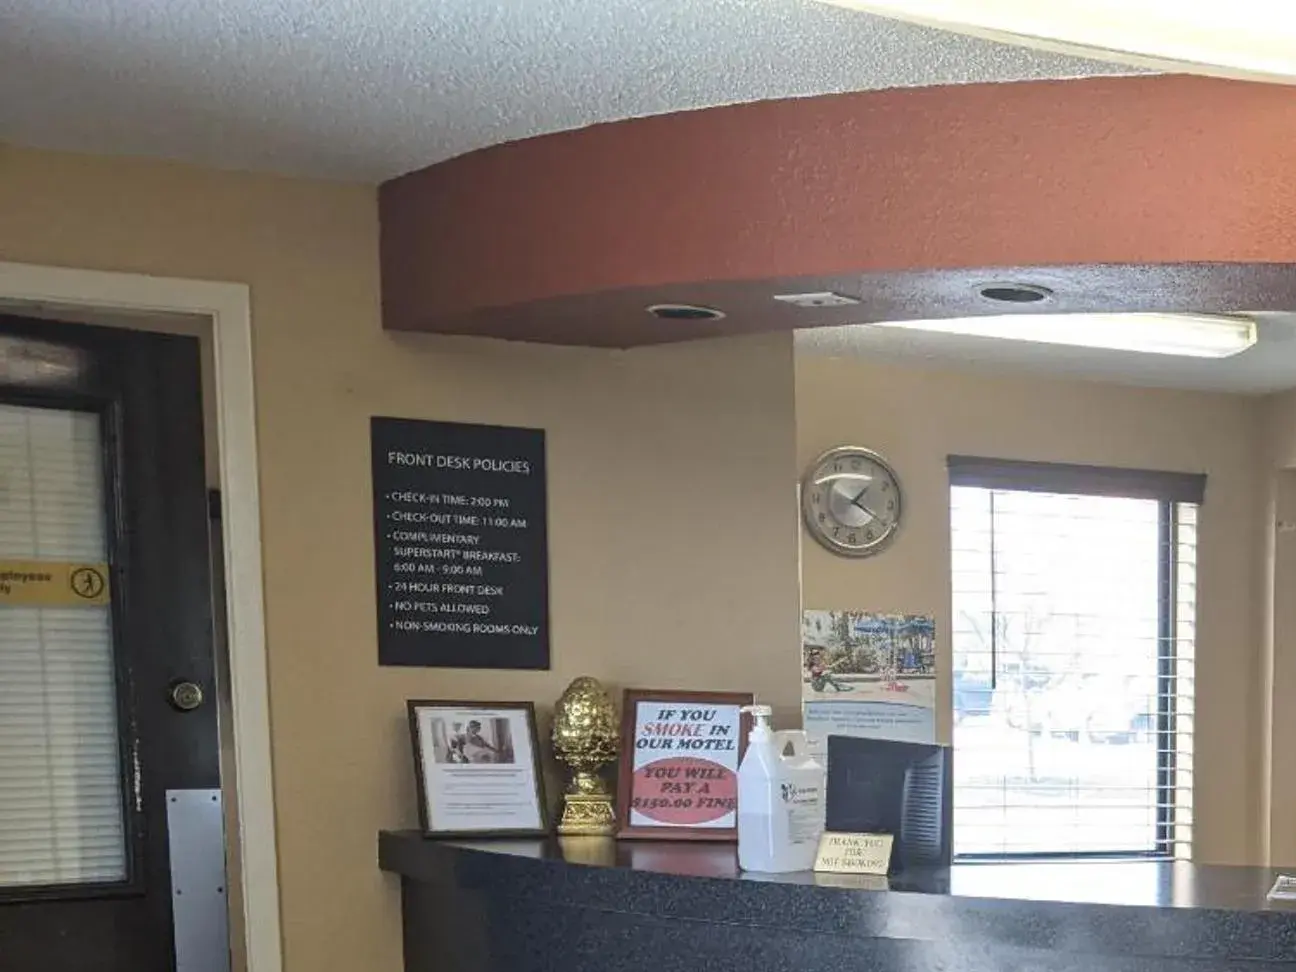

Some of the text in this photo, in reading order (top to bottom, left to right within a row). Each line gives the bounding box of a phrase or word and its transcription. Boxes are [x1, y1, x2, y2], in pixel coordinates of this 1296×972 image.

[388, 452, 531, 474] FRONT DESK POLICIES
[392, 491, 510, 508] CHECK-IN TIME: 2:00 PM
[392, 511, 450, 525] CHECK-OUT
[482, 516, 508, 528] 11:00
[510, 518, 527, 529] AM
[393, 531, 480, 545] COMPLIMENTARY
[463, 551, 521, 563] BREAKFAST:
[418, 564, 435, 574] AM
[466, 566, 483, 577] AM
[409, 582, 440, 594] HOUR
[442, 584, 475, 596] FRONT
[478, 585, 504, 597] DESK
[395, 602, 490, 615] NO PETS ALLOWED
[395, 621, 539, 636] NON-SMOKING ROOMS ONLY
[658, 709, 717, 722] IF YOU
[641, 721, 731, 737] SMOKE IN
[636, 736, 736, 751] OUR MOTEL
[643, 766, 726, 780] YOU WILL
[660, 781, 711, 794] PAY A
[694, 797, 737, 810] FINE
